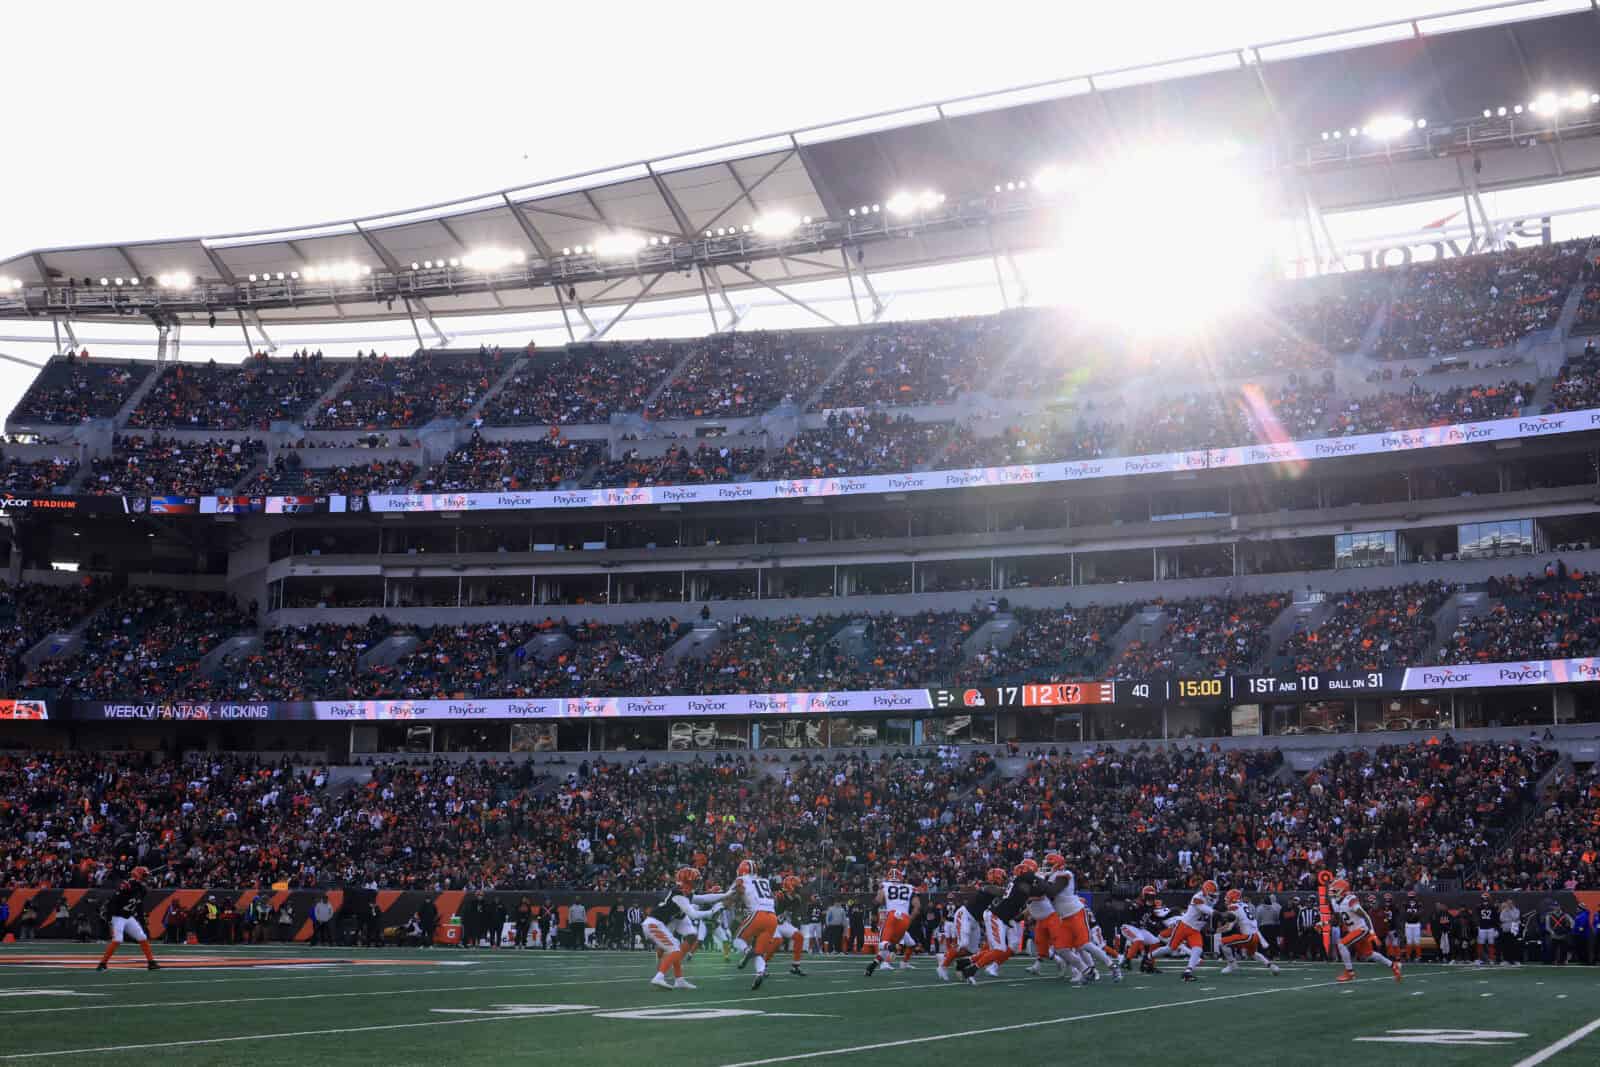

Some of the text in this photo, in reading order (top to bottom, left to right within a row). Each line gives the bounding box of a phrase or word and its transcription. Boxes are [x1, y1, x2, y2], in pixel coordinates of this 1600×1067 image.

[1519, 420, 1566, 433] Paycor
[1450, 428, 1495, 441] Paycor
[1315, 443, 1359, 454] Paycor
[1064, 466, 1103, 476] Paycor
[1125, 462, 1162, 472] Paycor
[831, 482, 866, 492] Paycor
[888, 479, 924, 489] Paycor
[663, 490, 697, 500] Paycor
[719, 488, 752, 498] Paycor
[32, 500, 77, 509] STADIUM
[498, 497, 531, 506] Paycor
[554, 495, 587, 504] Paycor
[1329, 673, 1383, 689] BALL ON 31
[1423, 673, 1471, 686] Paycor
[1500, 669, 1548, 682] Paycor
[1178, 679, 1222, 697] 15:00
[1249, 676, 1318, 693] 1ST AND 10
[997, 687, 1018, 705] 17
[1031, 685, 1052, 704] 12
[1132, 684, 1149, 698] 4Q
[749, 700, 787, 711] Paycor
[811, 698, 849, 709] Paycor
[874, 695, 912, 706] Paycor
[104, 705, 154, 718] WEEKLY
[157, 704, 210, 718] FANTASY
[220, 705, 268, 718] KICKING
[331, 706, 368, 716] Paycor
[390, 706, 428, 716] Paycor
[449, 705, 487, 716] Paycor
[509, 705, 547, 715] Paycor
[567, 704, 605, 714] Paycor
[627, 703, 665, 713] Paycor
[688, 701, 727, 712] Paycor
[752, 880, 774, 899] 19
[888, 886, 909, 900] 82
